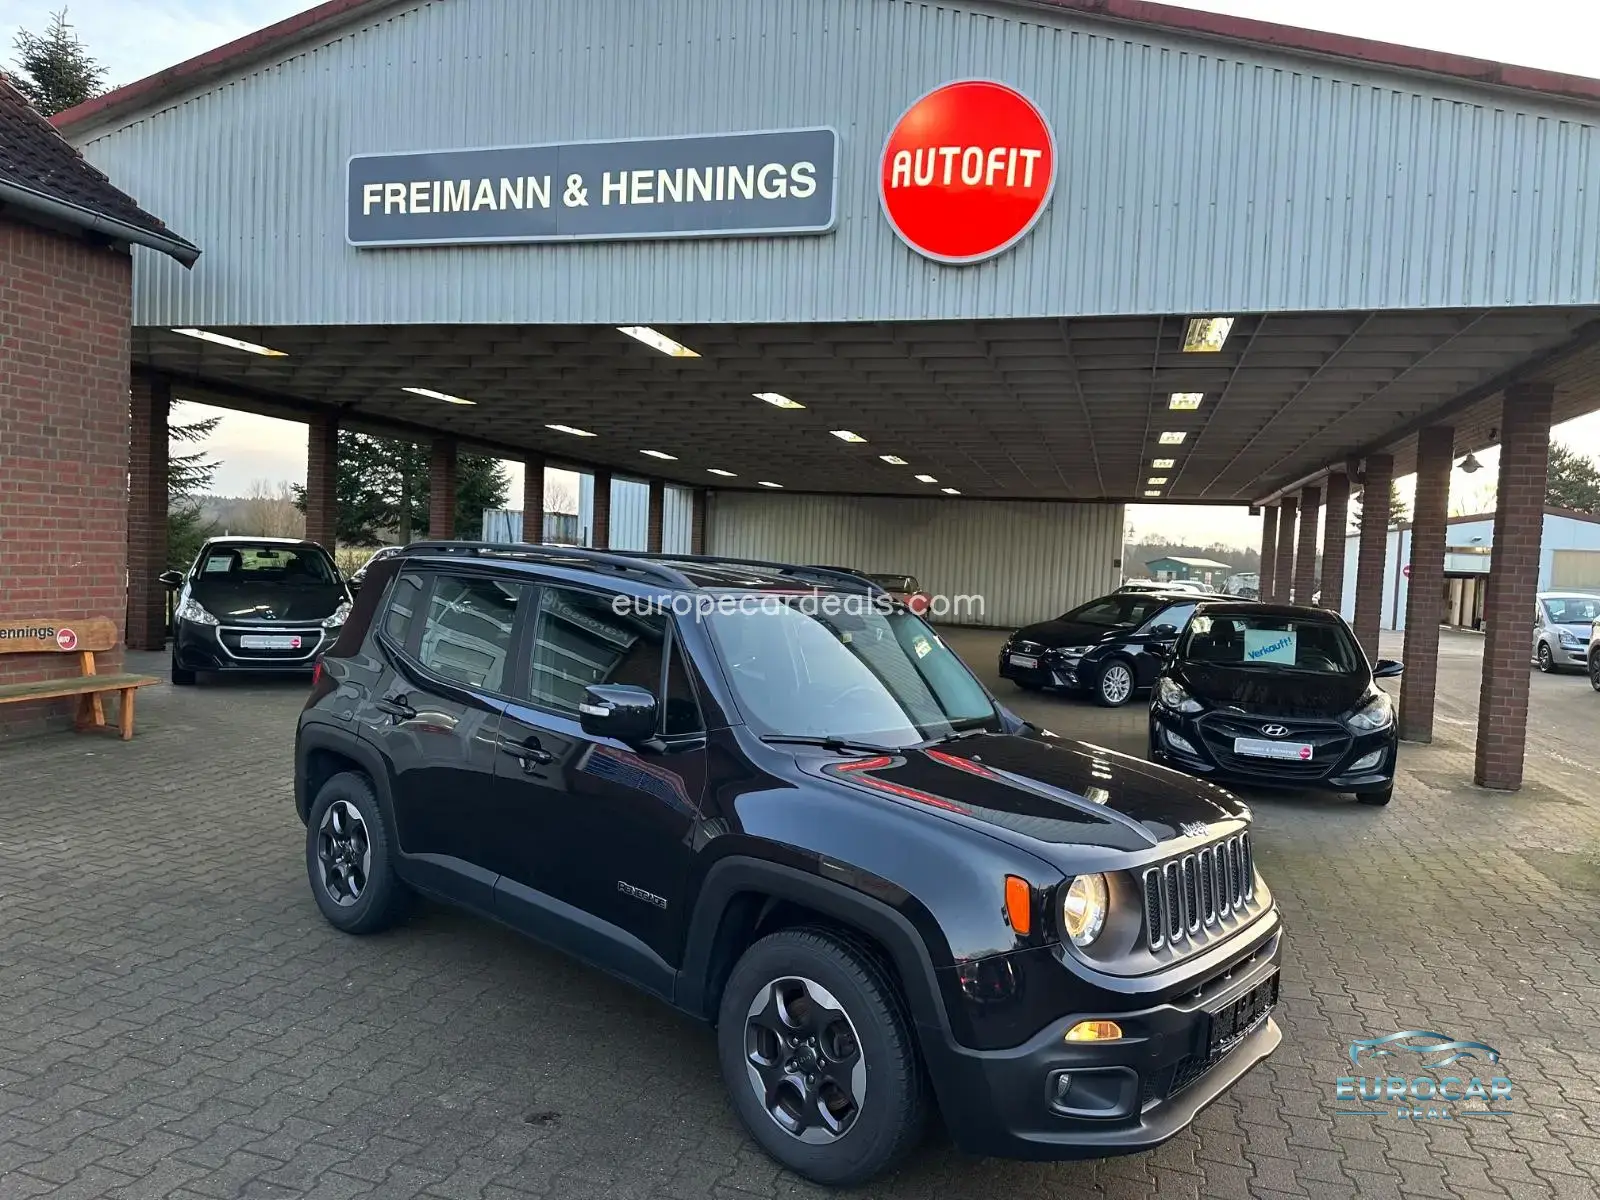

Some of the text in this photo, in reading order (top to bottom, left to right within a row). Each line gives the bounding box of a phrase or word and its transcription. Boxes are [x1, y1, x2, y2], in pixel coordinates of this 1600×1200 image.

[891, 146, 1042, 188] AUTOFIT
[363, 161, 817, 216] FREIMANN & HENNINGS
[1247, 636, 1293, 660] Verkauft!
